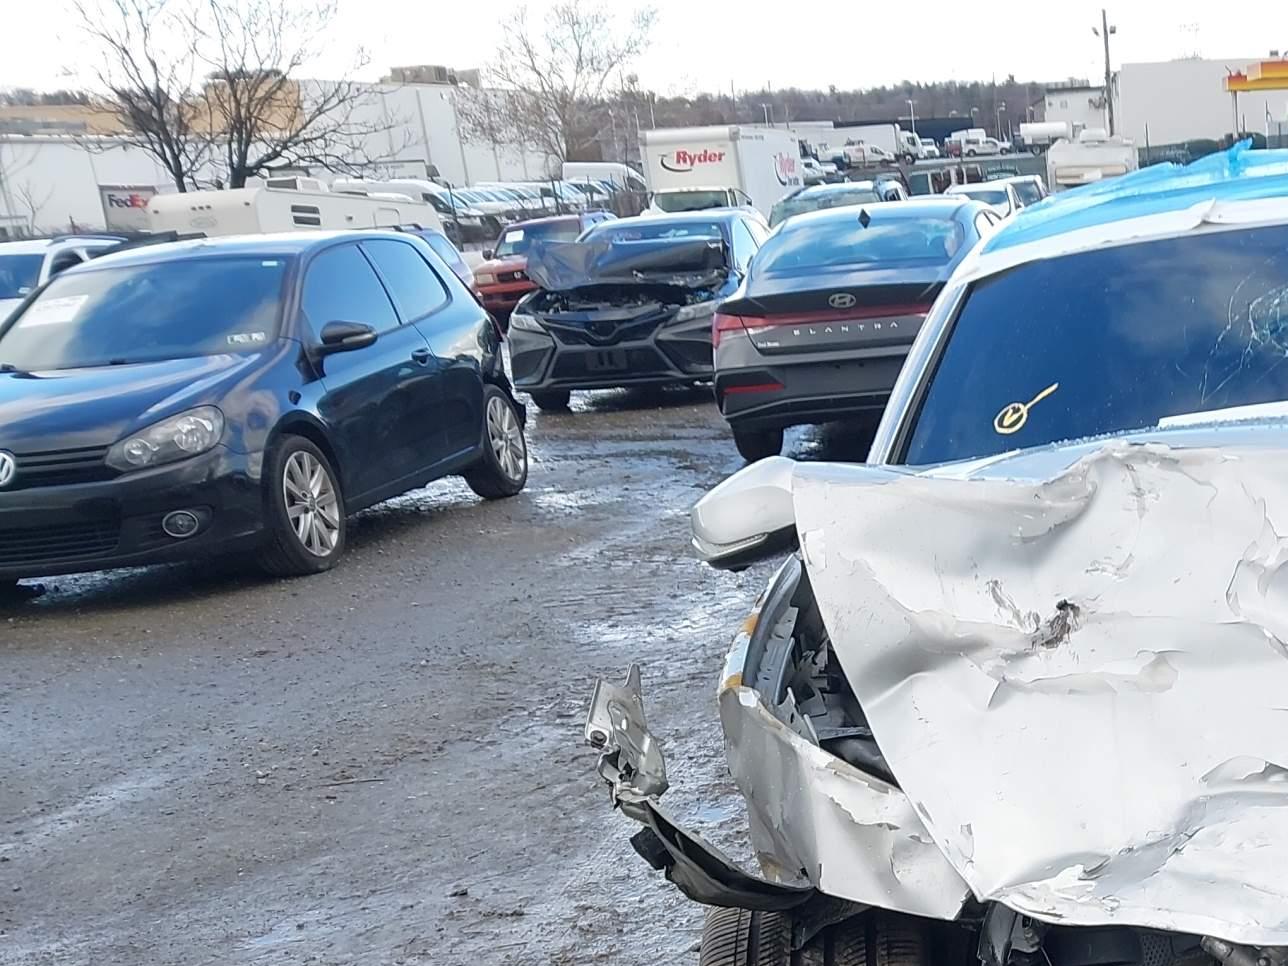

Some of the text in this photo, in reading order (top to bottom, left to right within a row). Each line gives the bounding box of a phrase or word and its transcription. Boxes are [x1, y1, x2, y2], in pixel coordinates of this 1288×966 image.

[675, 149, 726, 168] Ryder
[108, 193, 149, 208] FedEx
[793, 321, 898, 336] ELANTRA
